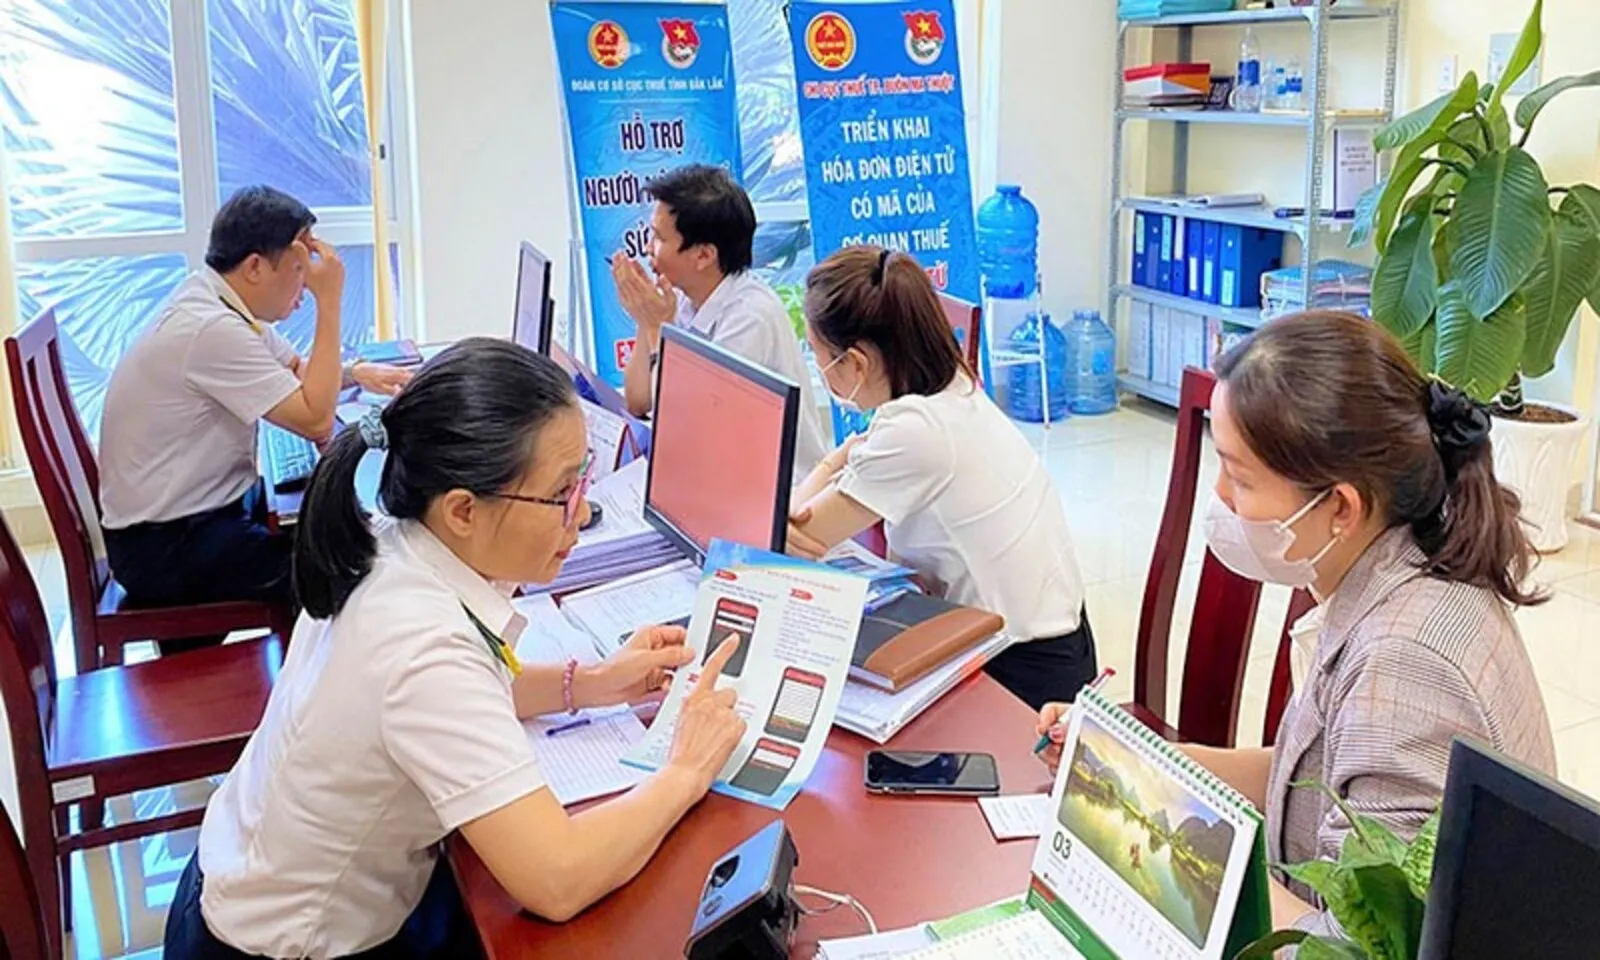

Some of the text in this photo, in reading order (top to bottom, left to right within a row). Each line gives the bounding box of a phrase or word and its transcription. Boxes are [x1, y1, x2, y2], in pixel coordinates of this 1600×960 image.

[650, 118, 684, 155] TRỢ
[840, 109, 931, 143] TRIỂN KHAI
[821, 144, 956, 183] HÓA ĐƠN ĐIỆN TỬ
[584, 170, 641, 207] NGƯỜI
[851, 183, 935, 219] CÓ MÃ CỦA
[912, 220, 950, 251] THUẾ
[1053, 831, 1072, 859] 03
